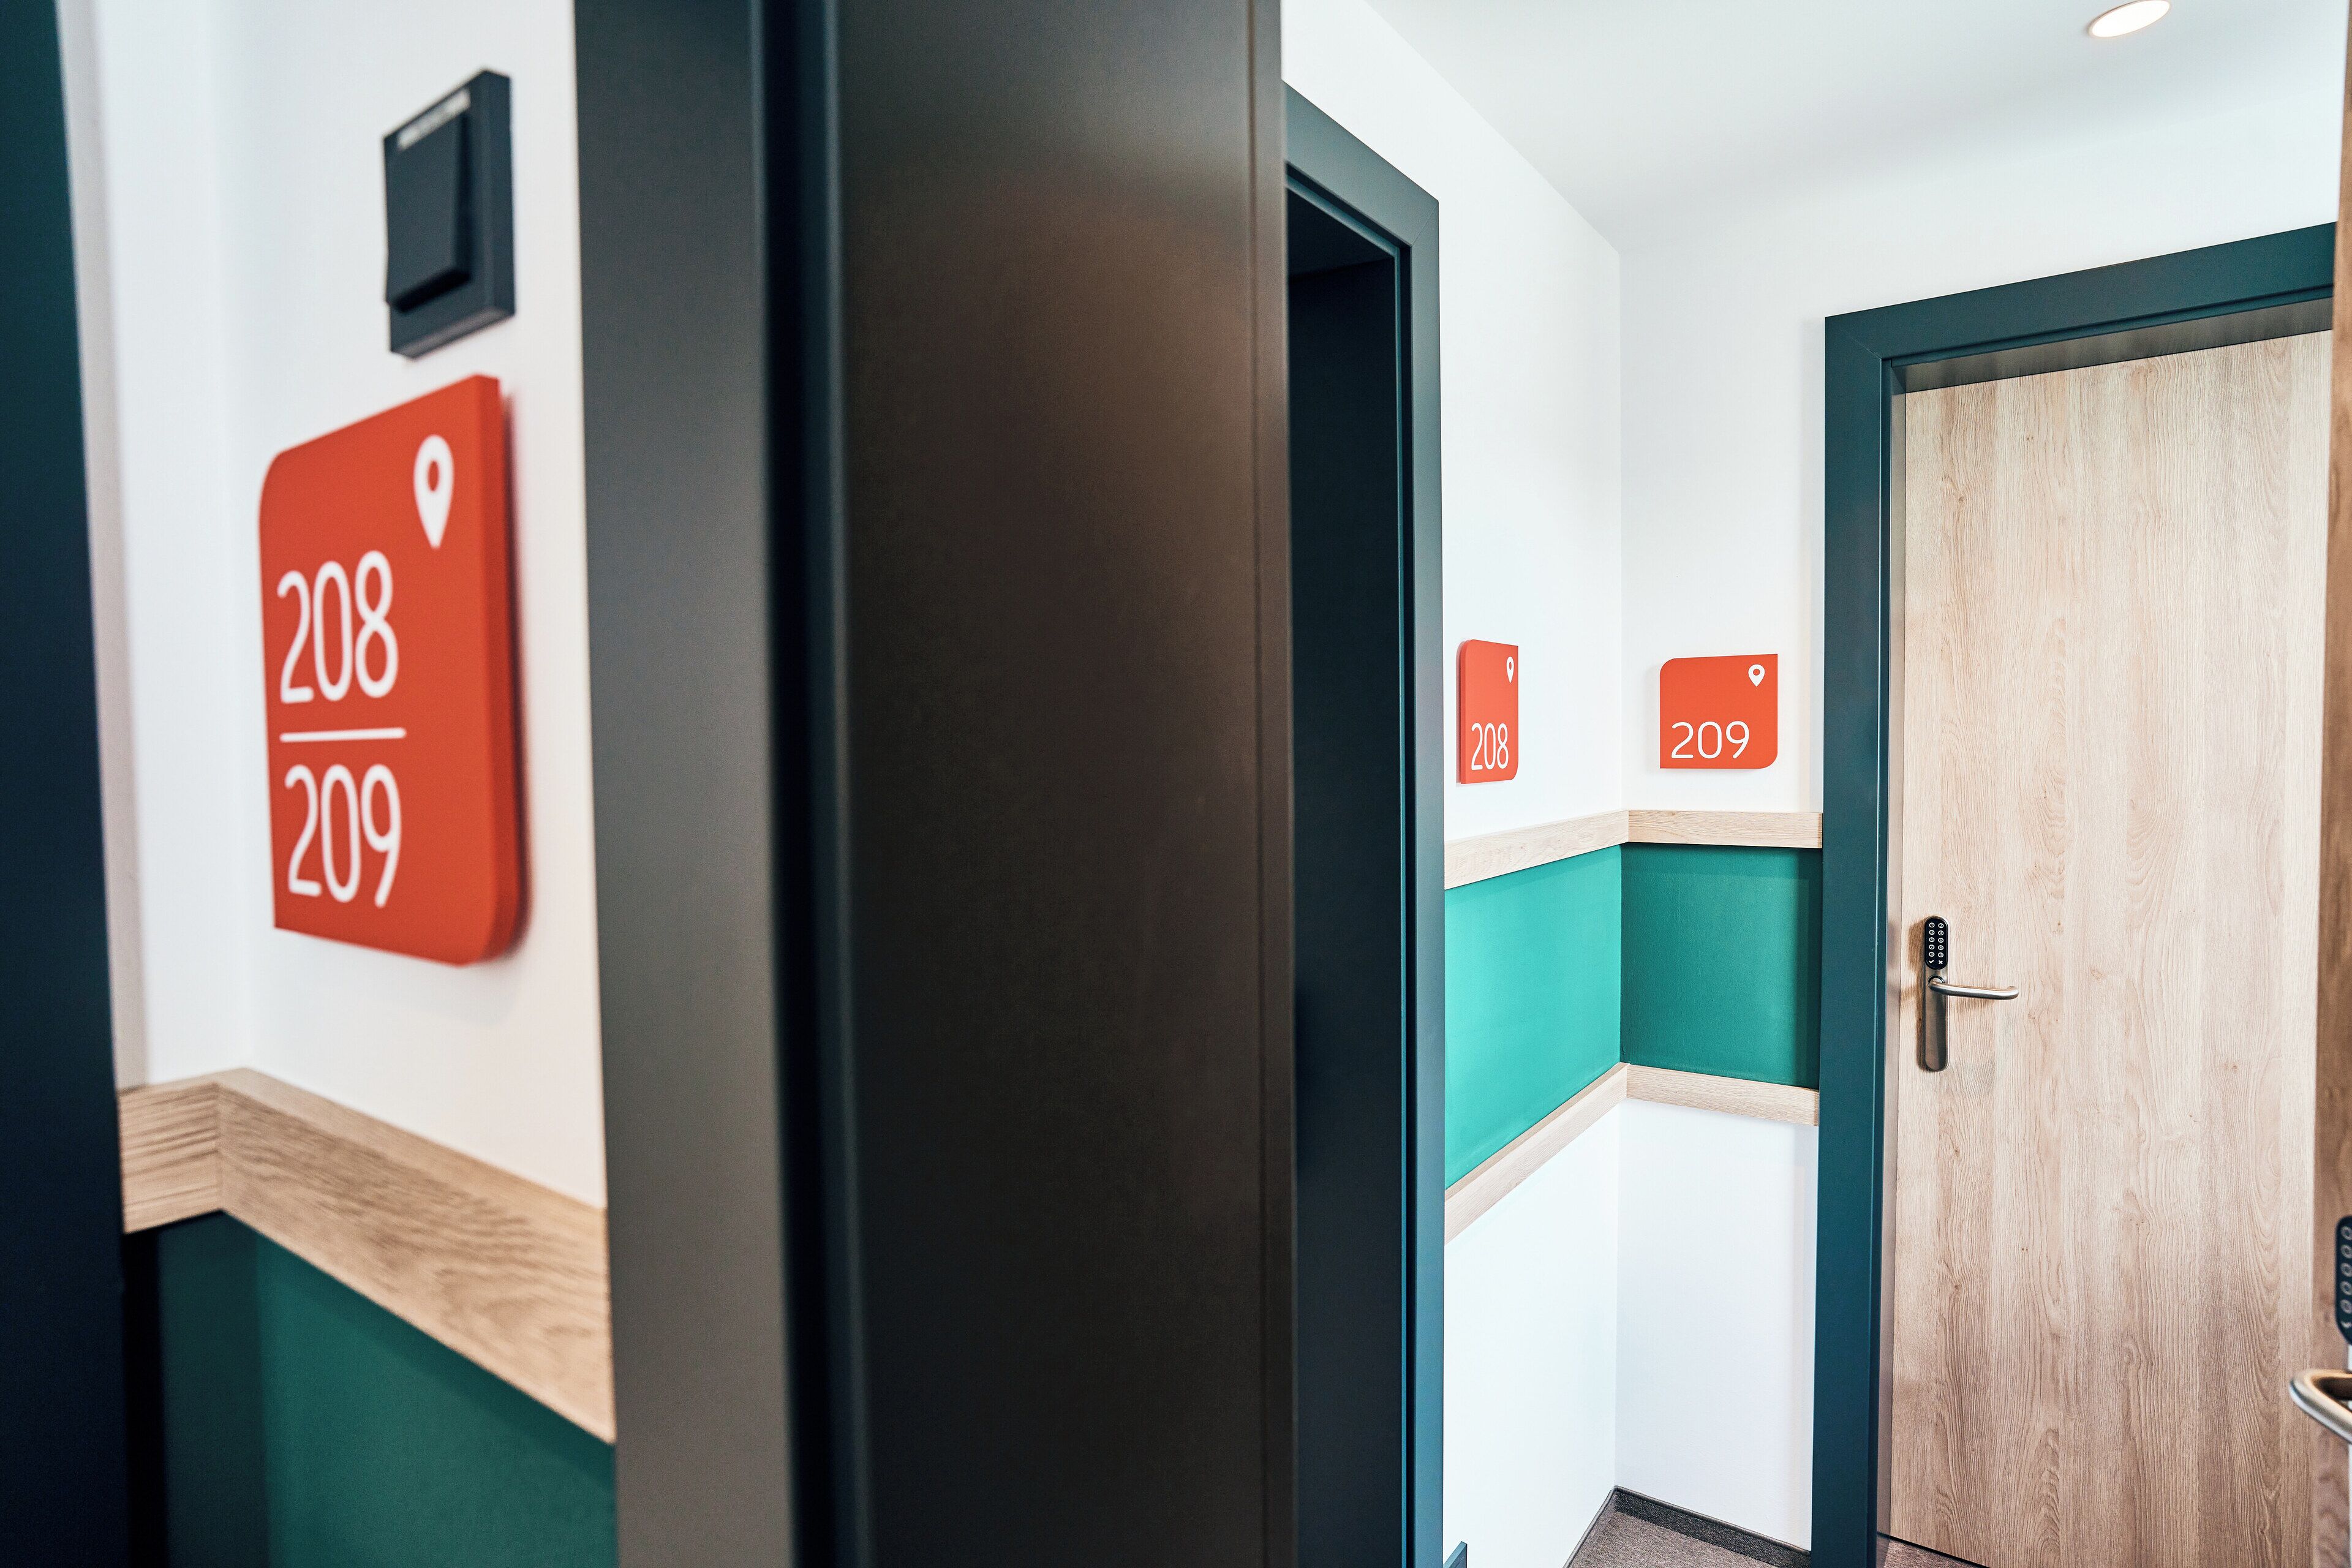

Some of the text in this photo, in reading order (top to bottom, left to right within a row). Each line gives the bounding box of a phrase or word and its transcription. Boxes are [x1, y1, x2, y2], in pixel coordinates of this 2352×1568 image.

[277, 550, 399, 704] 208
[1471, 722, 1509, 771] 208
[1671, 721, 1750, 759] 209
[285, 764, 402, 908] 209
